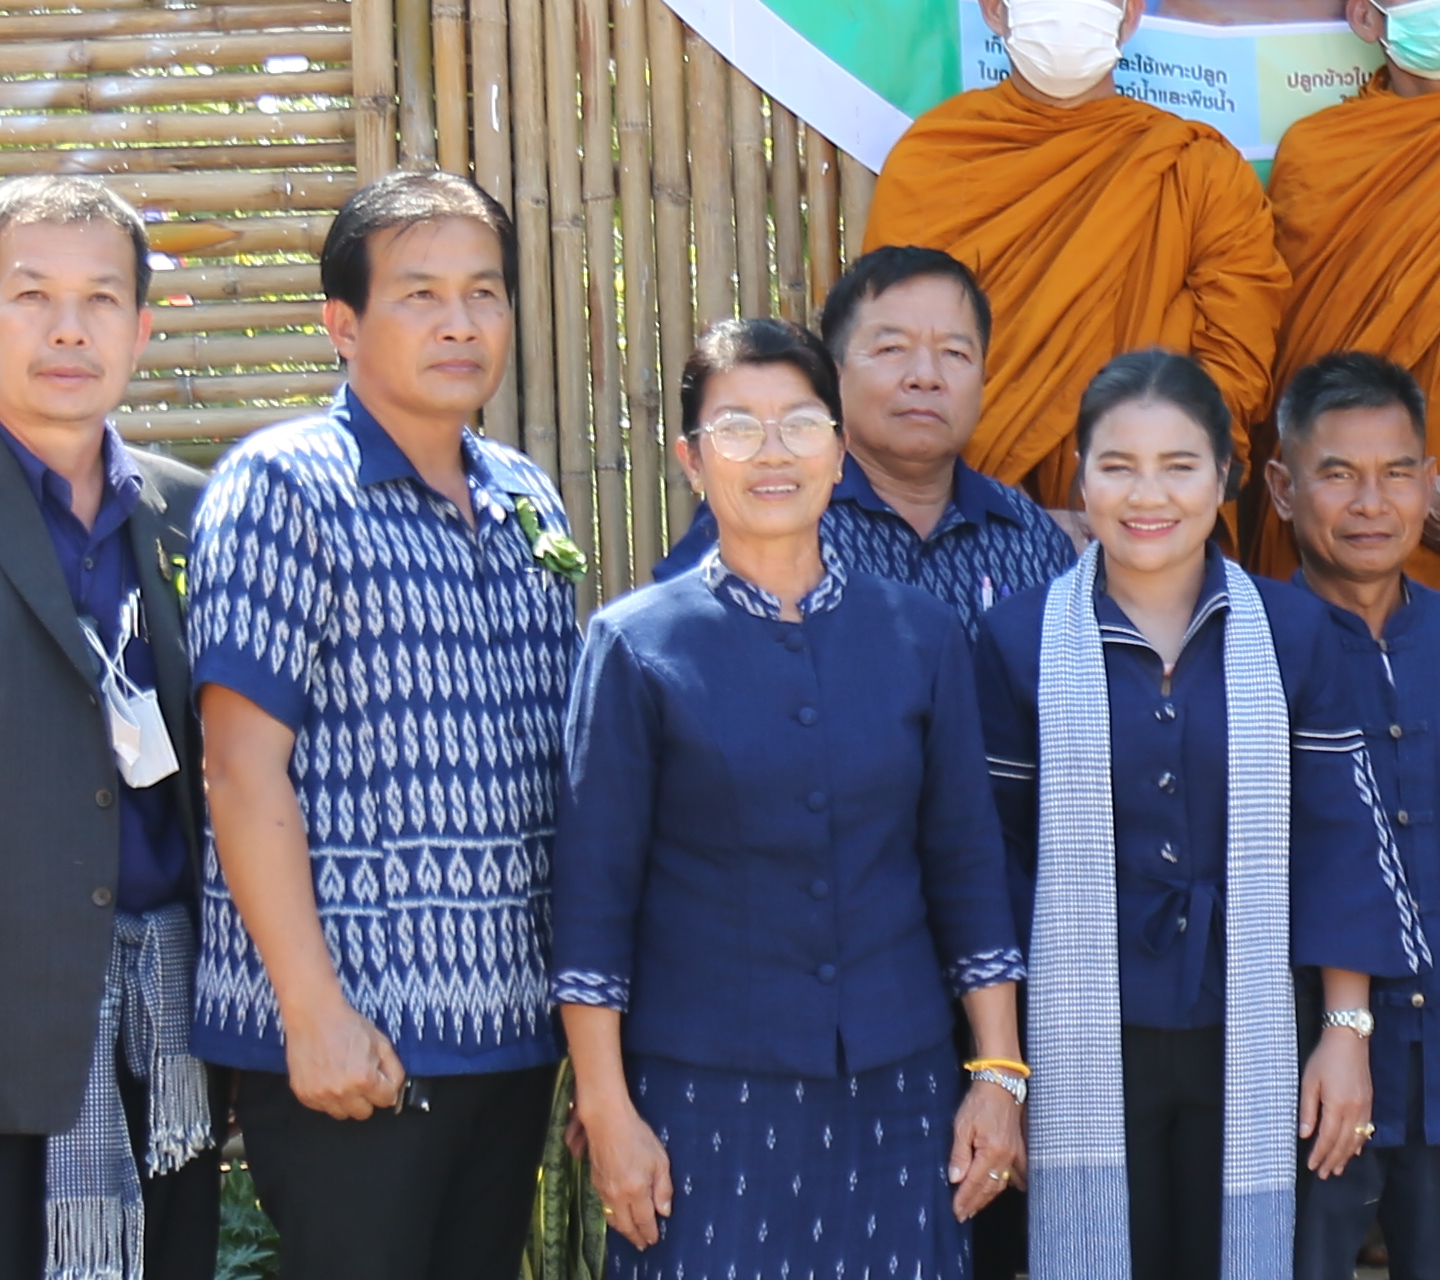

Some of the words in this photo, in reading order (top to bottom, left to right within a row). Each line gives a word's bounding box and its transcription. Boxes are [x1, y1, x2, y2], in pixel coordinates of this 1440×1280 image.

[1117, 53, 1227, 88] ละใช้เพาะปลูก
[1287, 66, 1373, 93] ปลูกข้าวใน
